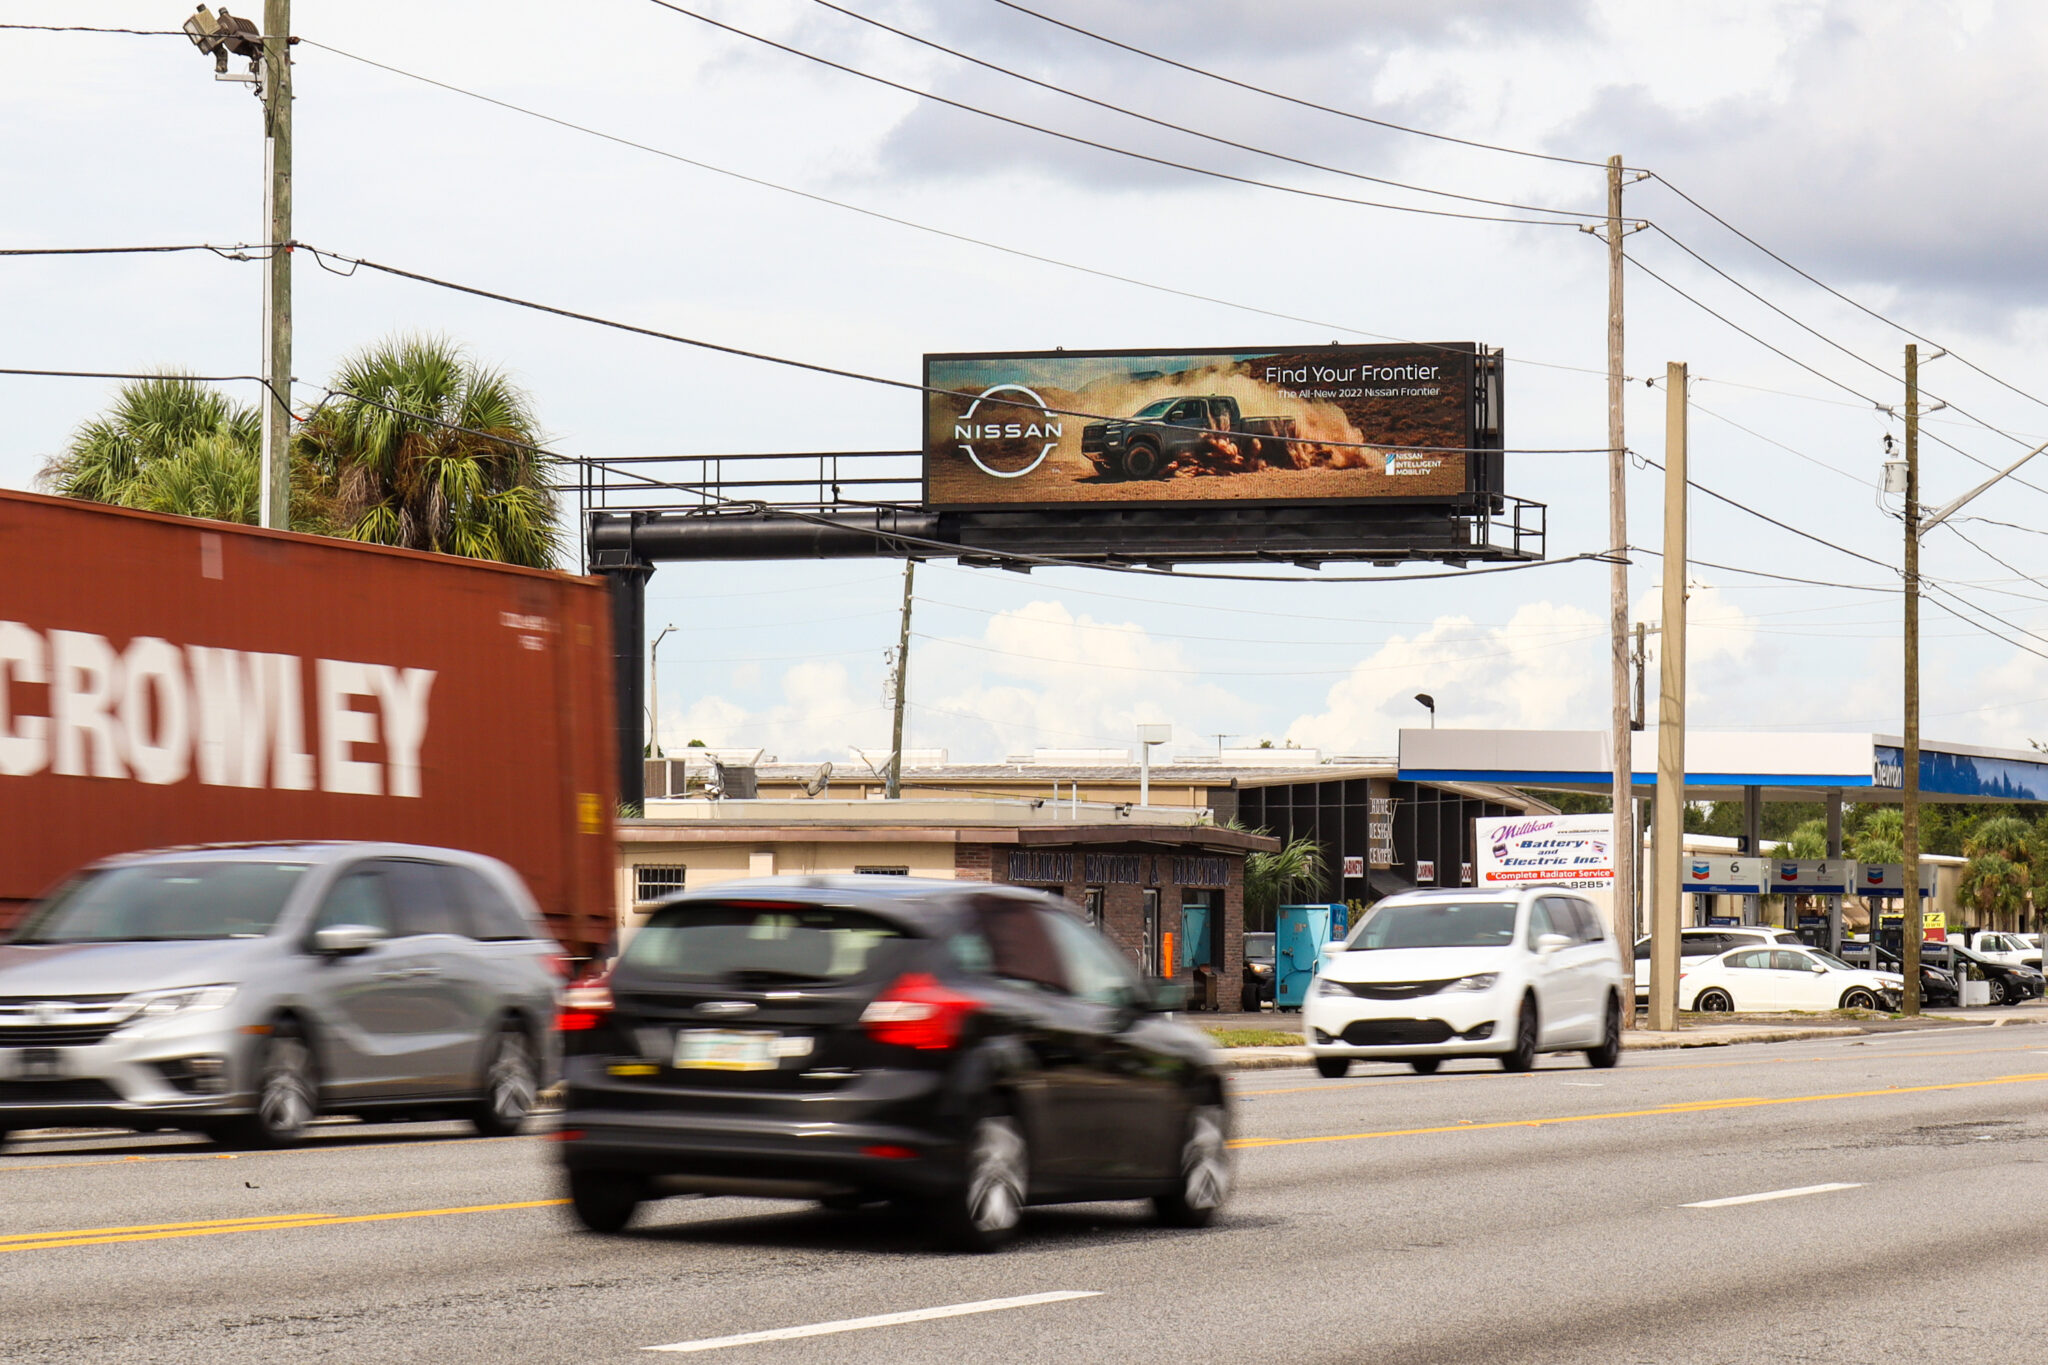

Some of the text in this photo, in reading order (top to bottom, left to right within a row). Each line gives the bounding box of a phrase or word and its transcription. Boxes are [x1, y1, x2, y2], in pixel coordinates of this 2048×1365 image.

[1266, 363, 1441, 383] Find Your Frontier.
[1277, 390, 1296, 399] The
[1299, 389, 1337, 399] All-New
[1338, 388, 1362, 398] 2022
[1364, 387, 1399, 397] Nissan
[954, 422, 1063, 440] NISSAN
[1396, 452, 1423, 460] NISSAN
[1396, 460, 1442, 468] INTELLIGENT
[0, 620, 437, 798] CROWLEY
[1491, 820, 1554, 843] Millikan
[1520, 840, 1584, 848] Battery
[1503, 856, 1602, 866] Electric Inc.
[1730, 861, 1740, 873] 6
[1085, 855, 1140, 884] BATTERY
[1540, 870, 1577, 878] Radiator
[1817, 863, 1827, 874] 4
